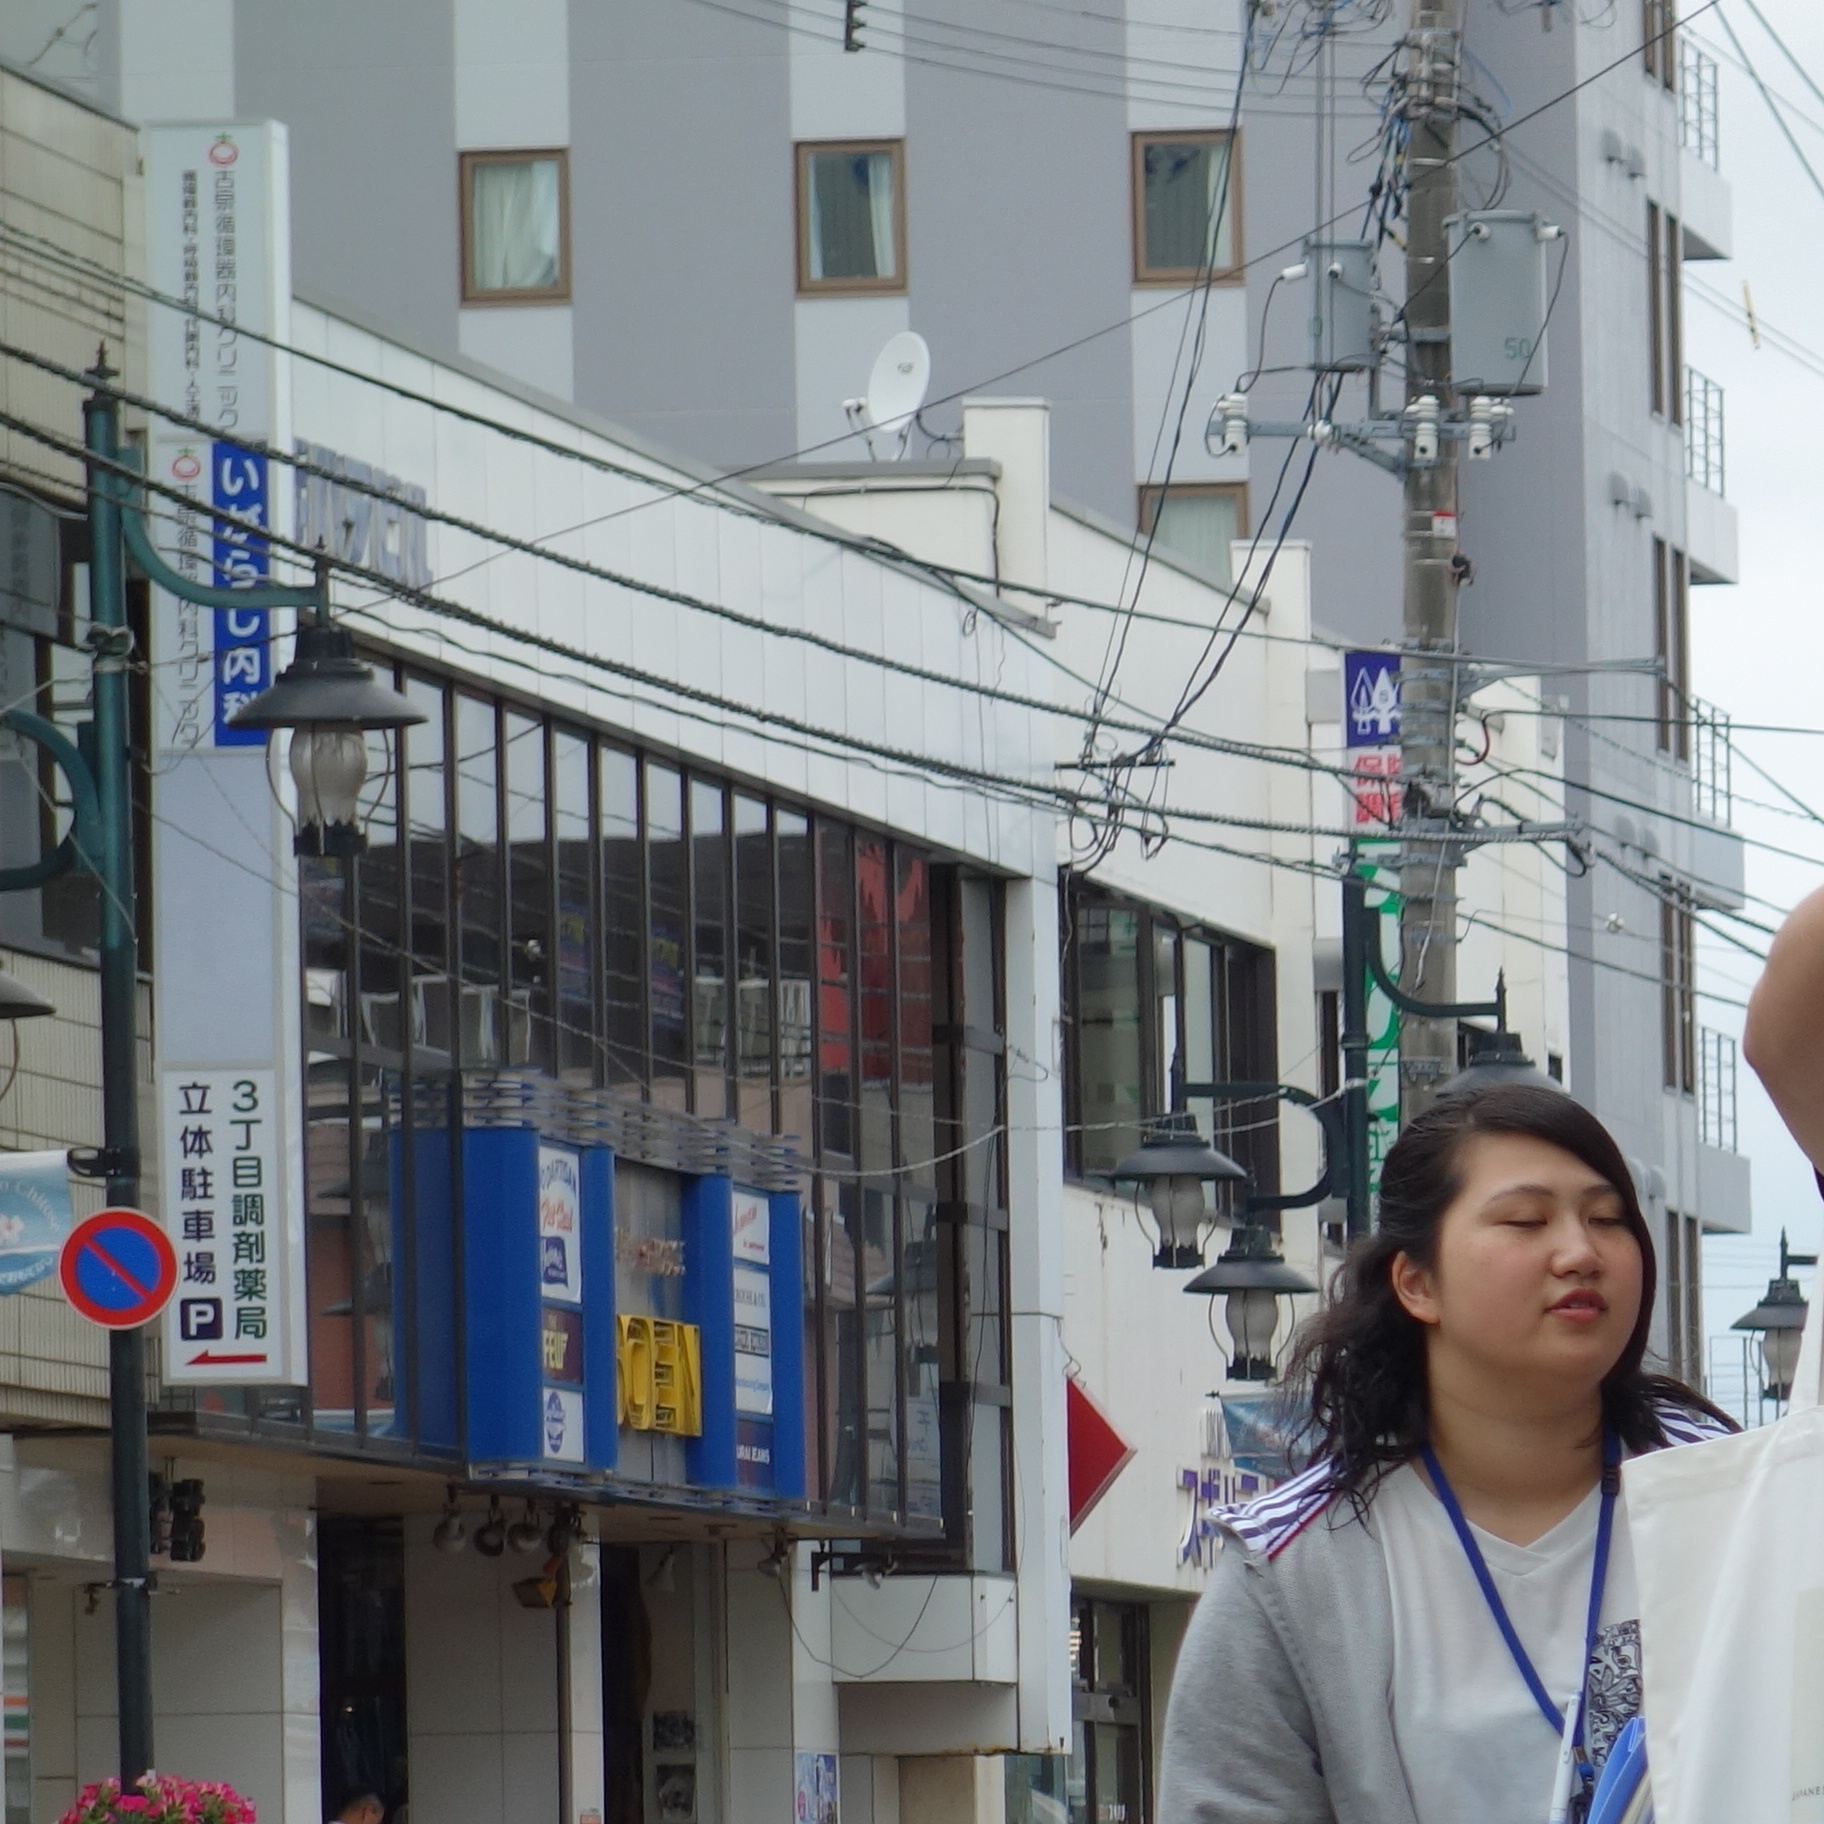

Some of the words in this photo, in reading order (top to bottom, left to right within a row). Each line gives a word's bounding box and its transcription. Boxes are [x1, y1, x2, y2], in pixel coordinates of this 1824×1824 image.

[179, 1081, 216, 1285] 立体駐車場
[229, 1079, 267, 1340] 3丁目調剤薬局
[189, 1303, 215, 1336] P
